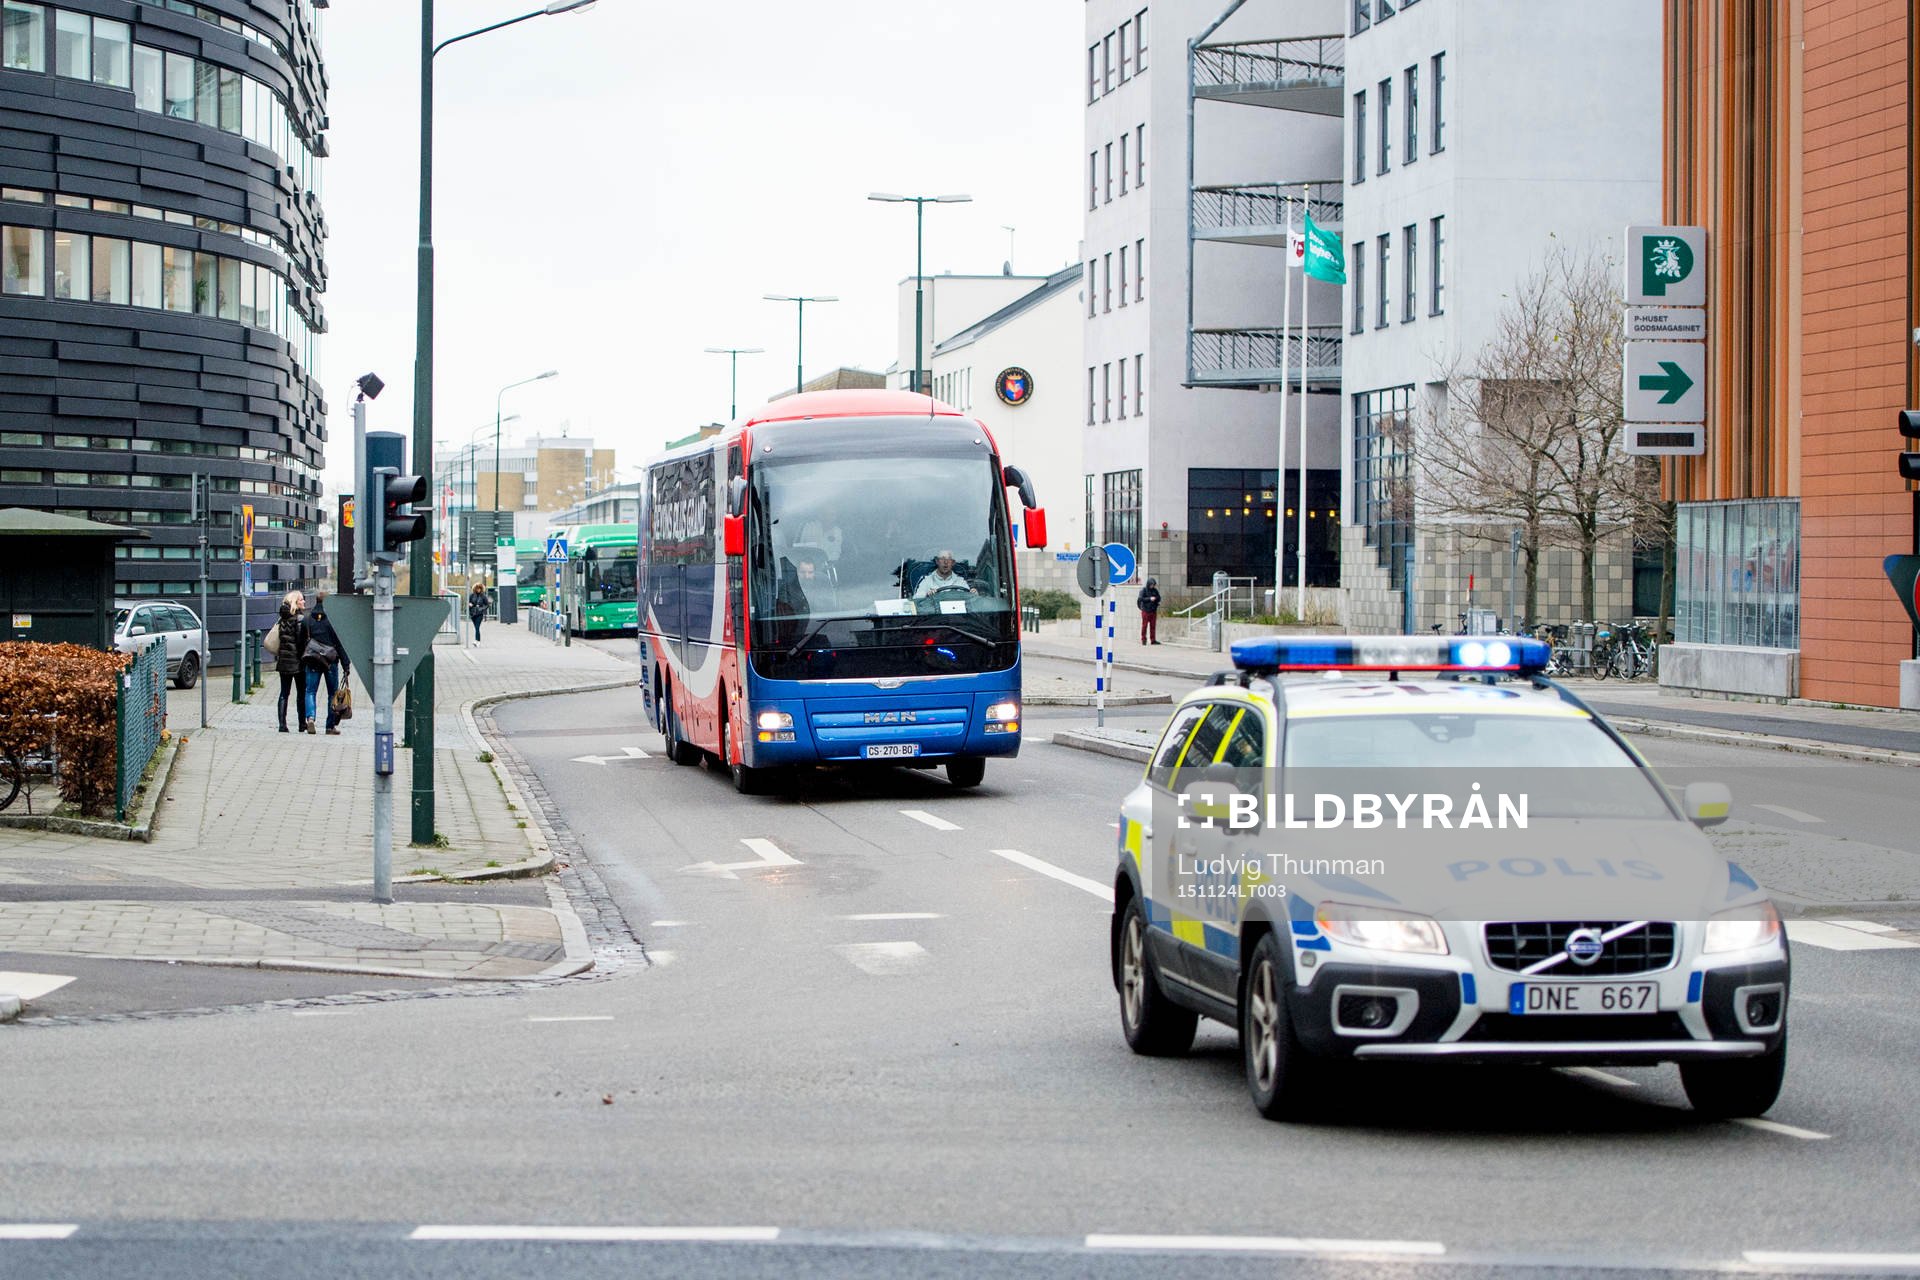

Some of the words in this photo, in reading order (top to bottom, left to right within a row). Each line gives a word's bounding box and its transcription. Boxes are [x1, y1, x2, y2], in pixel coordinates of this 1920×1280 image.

[1642, 235, 1694, 297] P
[1633, 315, 1669, 323] P-HUSET
[1633, 324, 1701, 332] GODSMAGASINET
[864, 711, 917, 724] MAN
[1446, 857, 1664, 882] POLIS
[1528, 987, 1579, 1011] DNE
[1601, 986, 1652, 1010] 667
